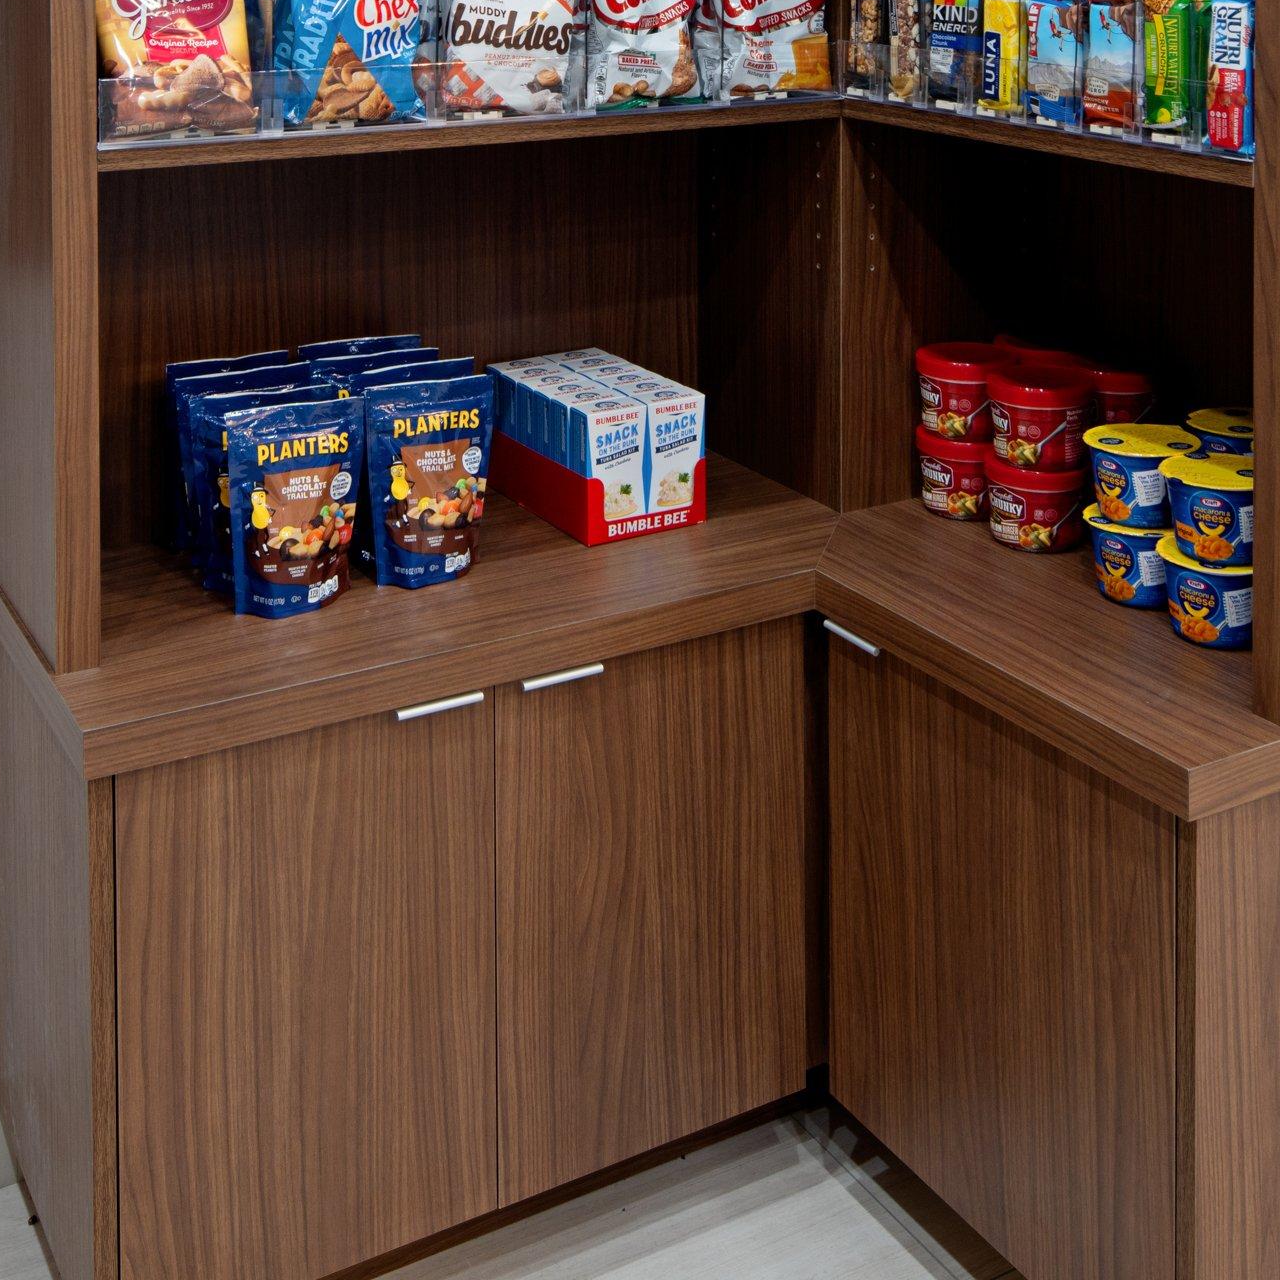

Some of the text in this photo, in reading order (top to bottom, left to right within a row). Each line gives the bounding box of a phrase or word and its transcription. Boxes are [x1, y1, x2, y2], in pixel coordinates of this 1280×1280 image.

[469, 5, 506, 17] MUDDY
[660, 1, 690, 26] SNACKS
[782, 2, 812, 21] SNACKS
[932, 5, 978, 22] KIND
[452, 3, 573, 55] buddies
[932, 33, 957, 41] Chocolate
[1215, 7, 1228, 64] GRAIN
[1227, 7, 1241, 64] NUTRI
[149, 39, 218, 48] Original Recipe
[365, 17, 416, 59] mix
[1163, 19, 1178, 57] NATURE
[621, 57, 638, 65] BAKED
[984, 38, 997, 95] LUNA
[655, 405, 683, 414] BUMBLE
[393, 409, 480, 439] PLANTERS
[595, 412, 639, 425] BUMBLE BEE
[655, 413, 696, 437] SNACK
[596, 423, 639, 448] SNACK
[658, 428, 695, 445] ON THE RUN!
[257, 432, 349, 466] PLANTERS
[424, 450, 445, 458] NUTS
[599, 438, 636, 456] ON THE RUN!
[416, 455, 456, 466] CHOCOLATE
[281, 481, 327, 494] CHOCOLATE
[289, 475, 320, 485] NUTS &
[287, 490, 322, 500] TRAIL MIX
[1202, 498, 1220, 507] Kraft
[990, 496, 1023, 516] CHUNKY
[608, 511, 688, 537] BUMBLE BEE
[1106, 540, 1122, 549] Kraft
[1188, 580, 1204, 590] Kraft
